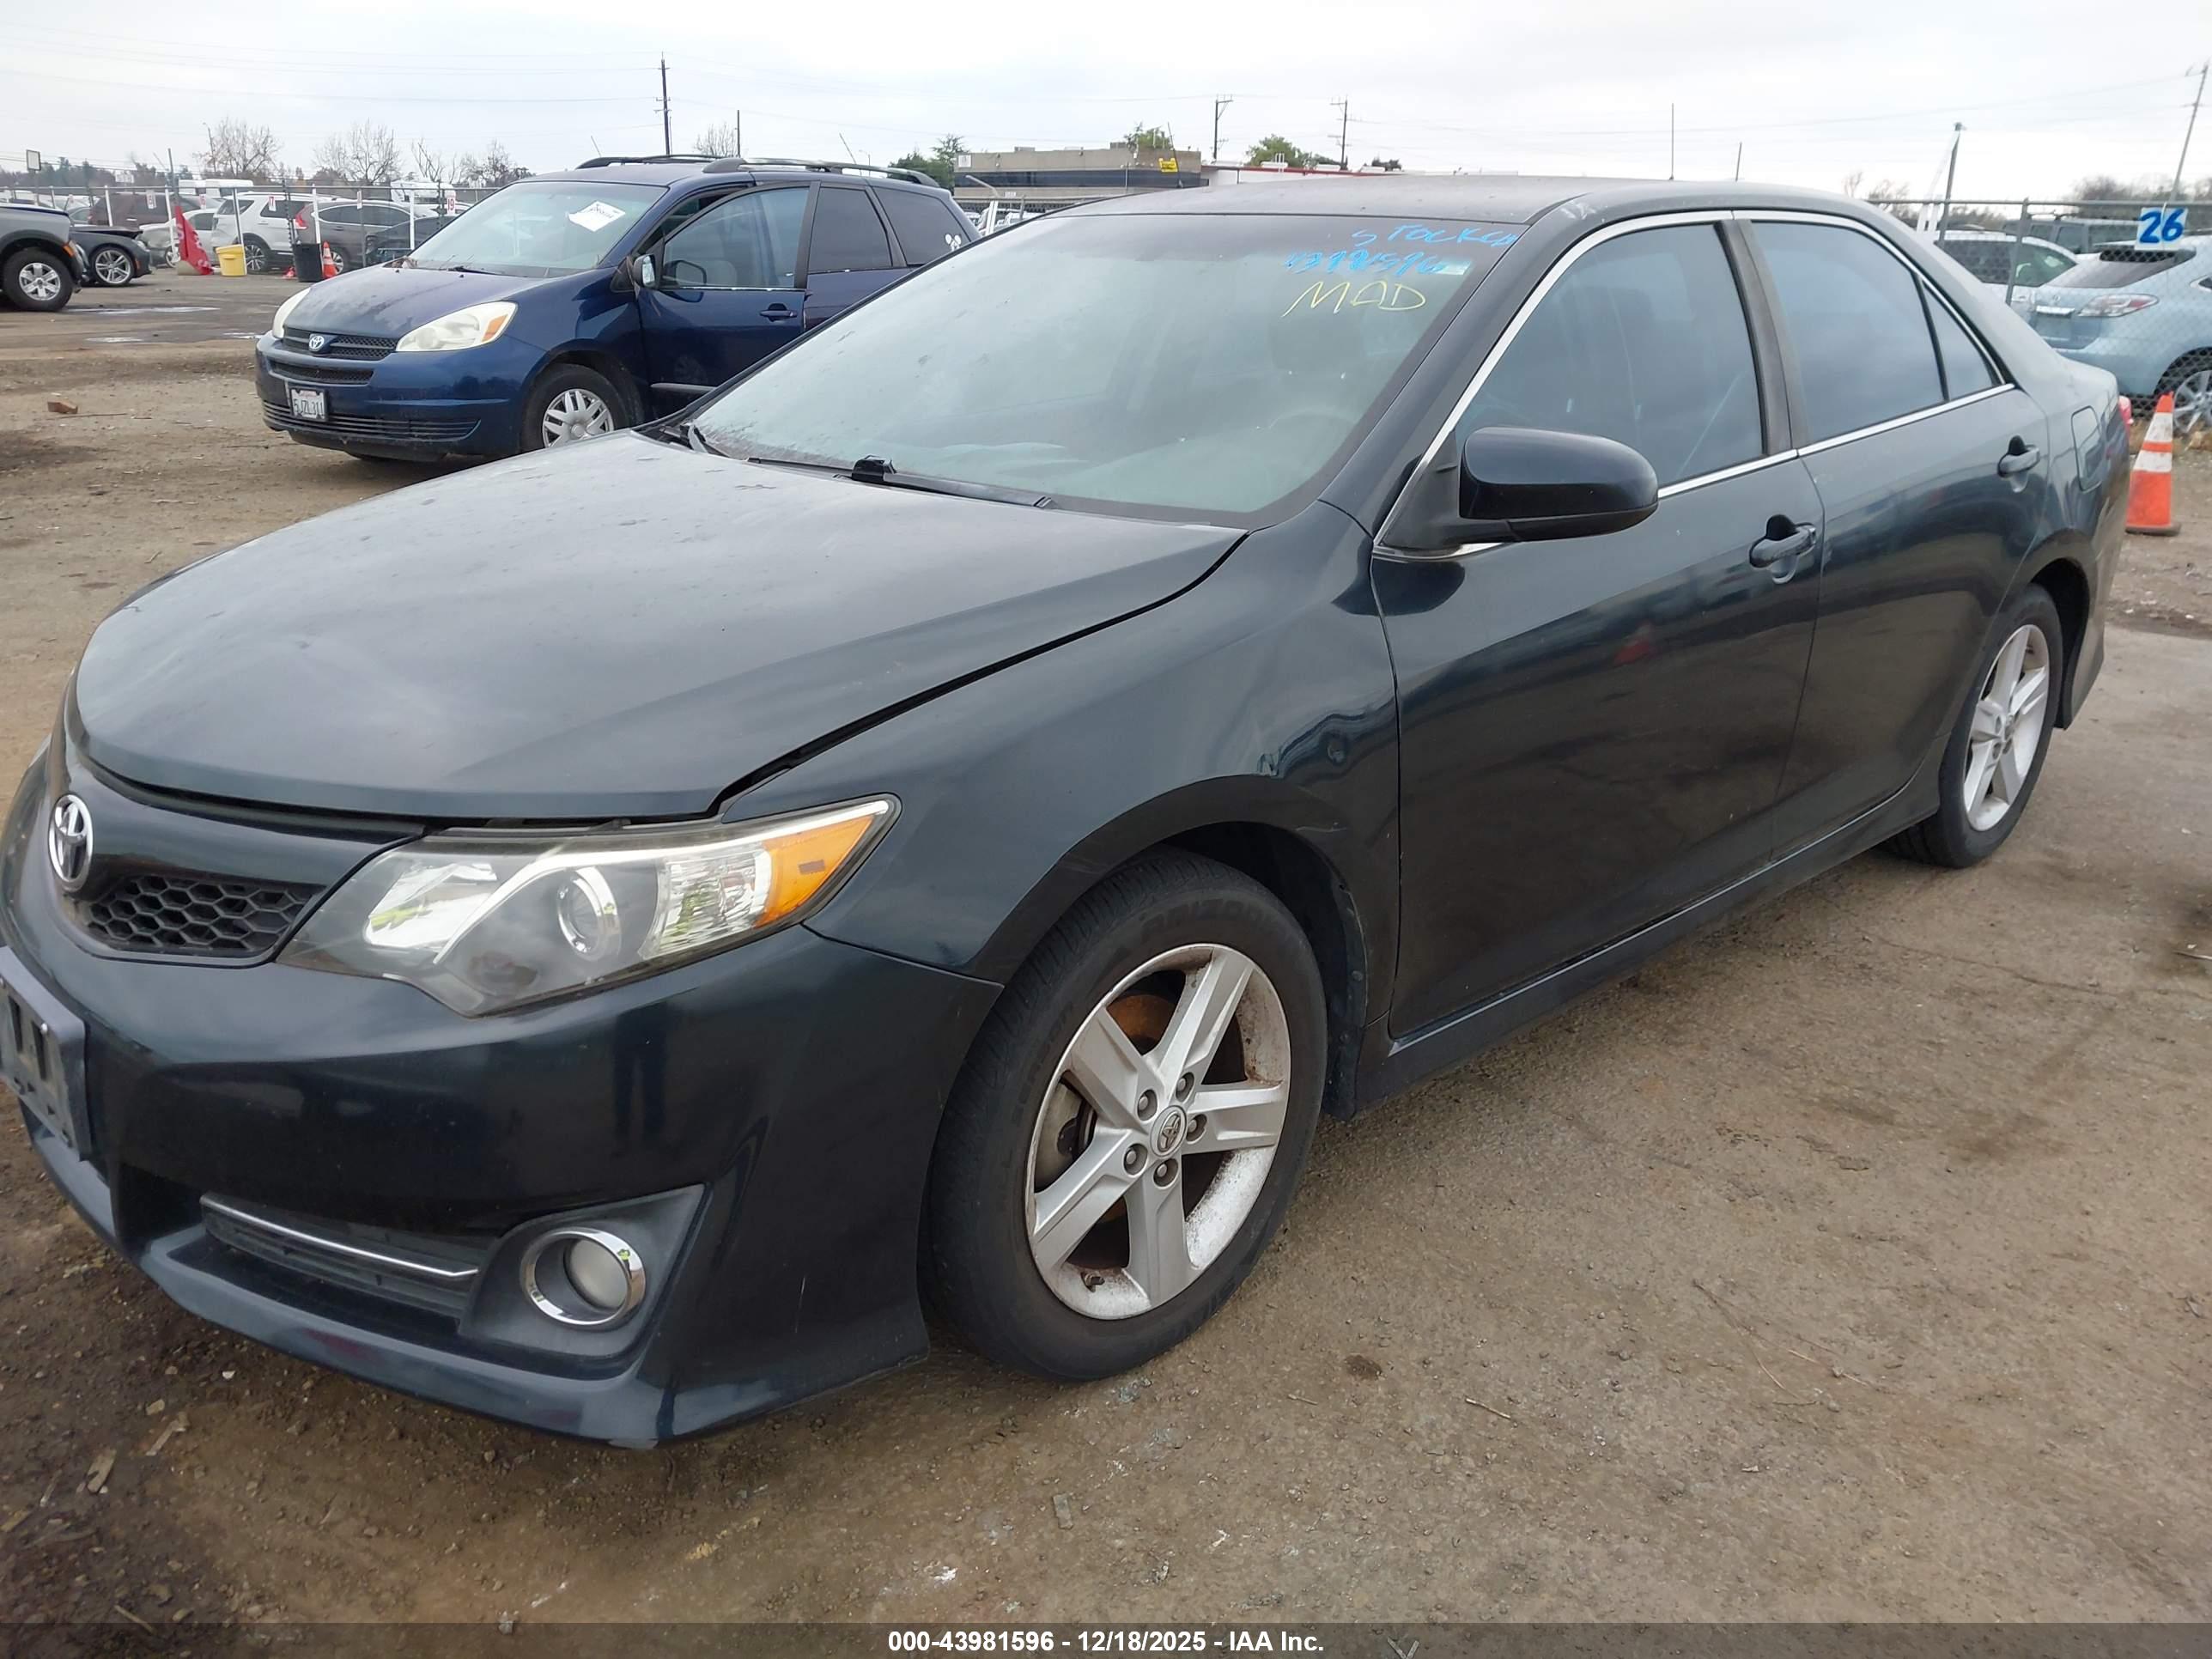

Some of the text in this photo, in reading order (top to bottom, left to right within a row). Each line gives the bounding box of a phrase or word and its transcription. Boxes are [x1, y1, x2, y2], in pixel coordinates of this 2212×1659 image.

[447, 198, 455, 211] 19
[2138, 209, 2185, 244] 26
[1280, 280, 1426, 318] MAD
